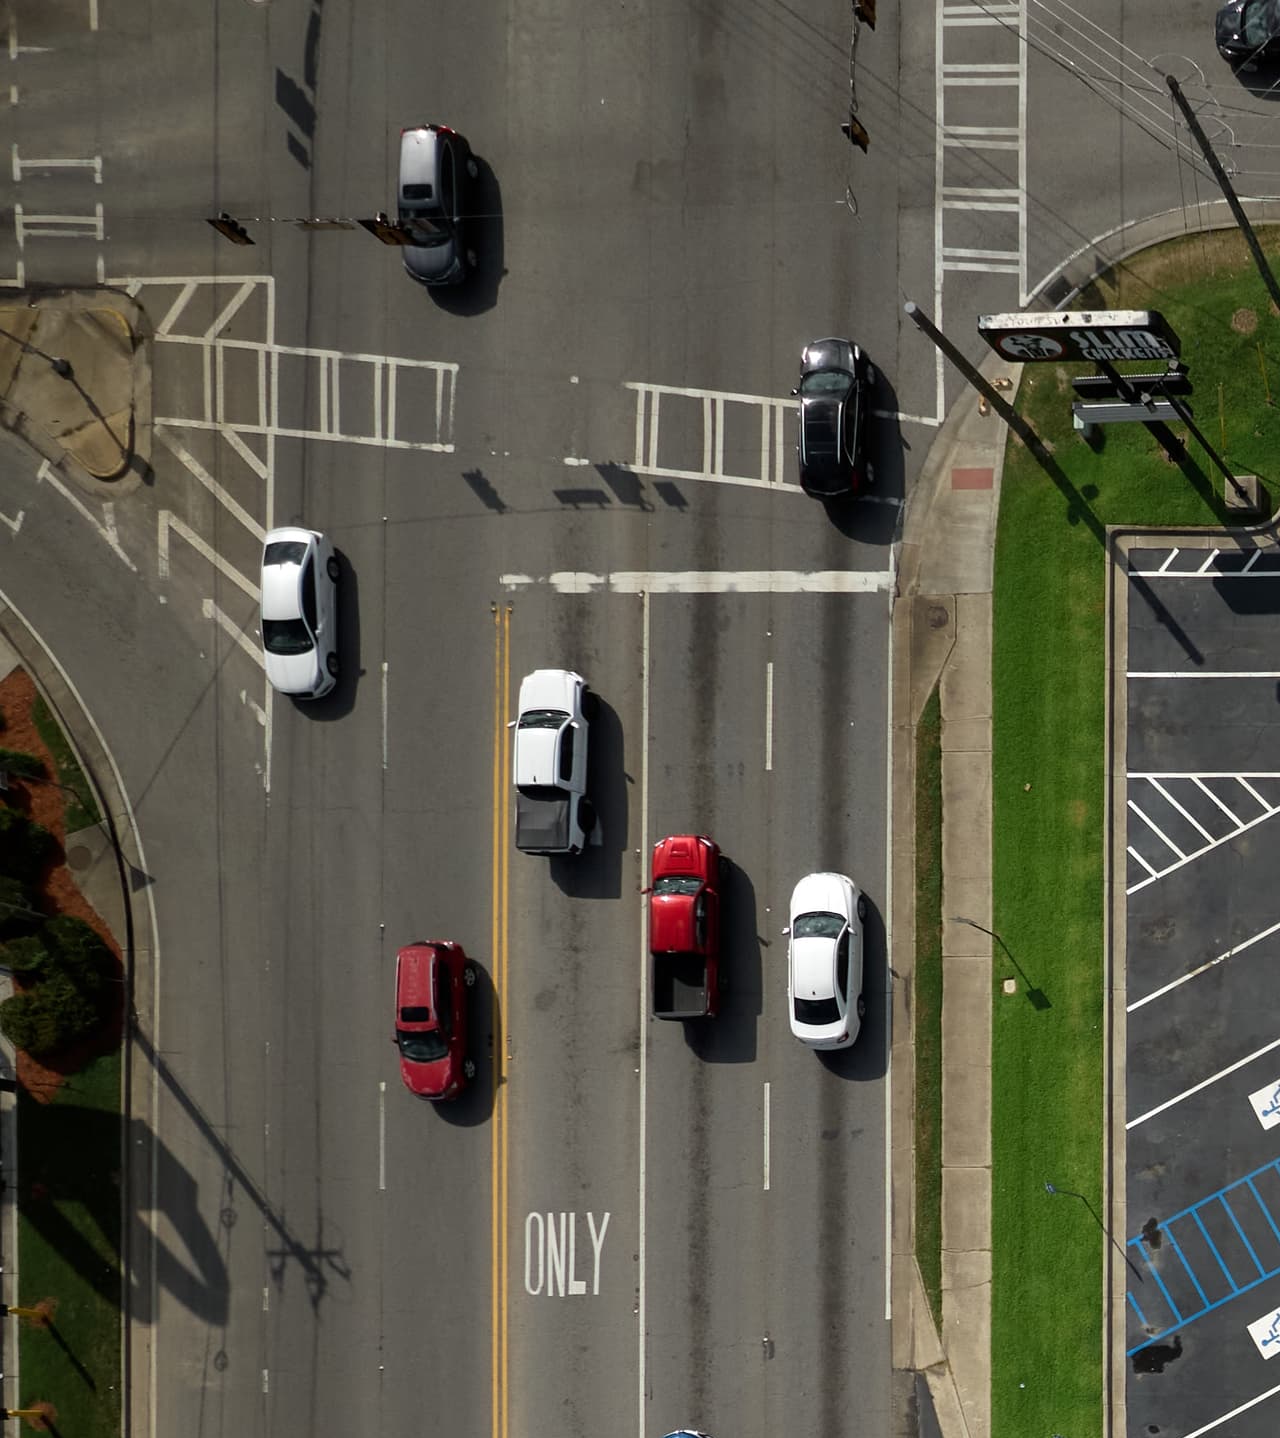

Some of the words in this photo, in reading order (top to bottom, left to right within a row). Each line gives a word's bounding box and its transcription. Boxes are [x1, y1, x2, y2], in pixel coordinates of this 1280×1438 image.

[1069, 330, 1162, 350] SLIM
[1081, 347, 1169, 361] CHICKENS
[525, 1211, 610, 1297] ONLY
